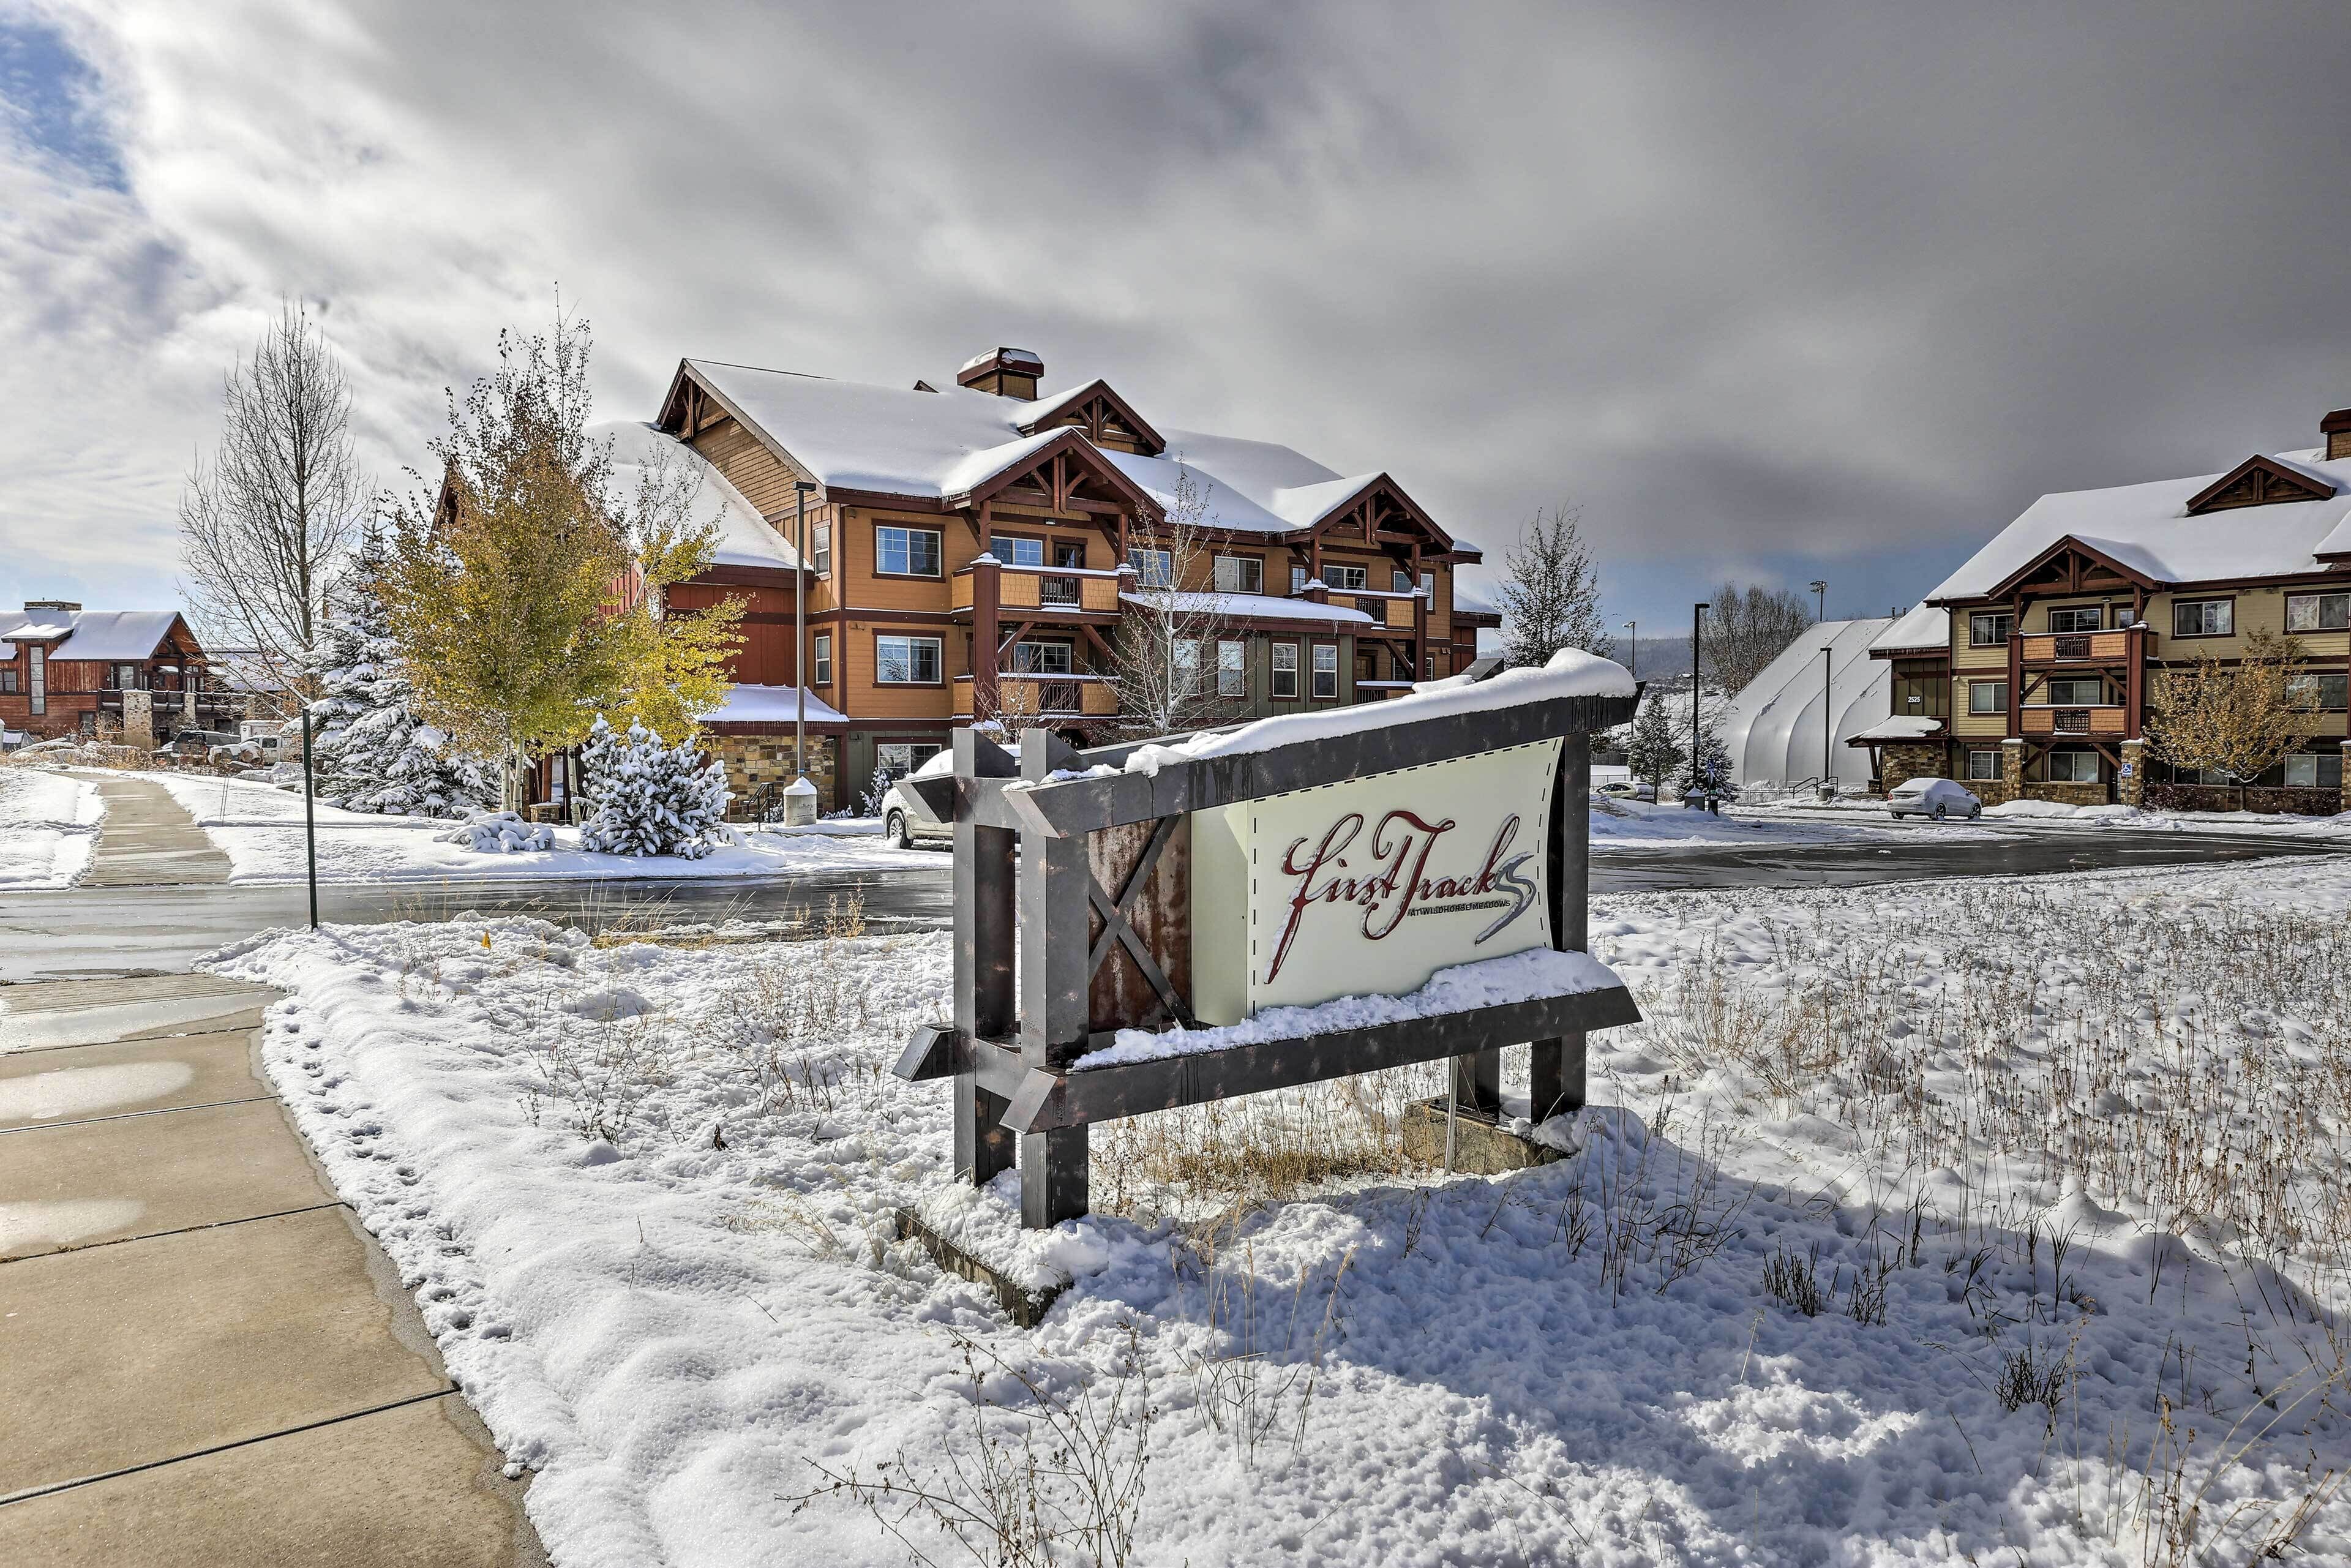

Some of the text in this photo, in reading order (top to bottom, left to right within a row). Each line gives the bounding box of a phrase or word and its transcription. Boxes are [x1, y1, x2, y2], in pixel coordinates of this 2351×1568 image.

[1409, 900, 1511, 917] AT WILDHORSE MEADOWS
